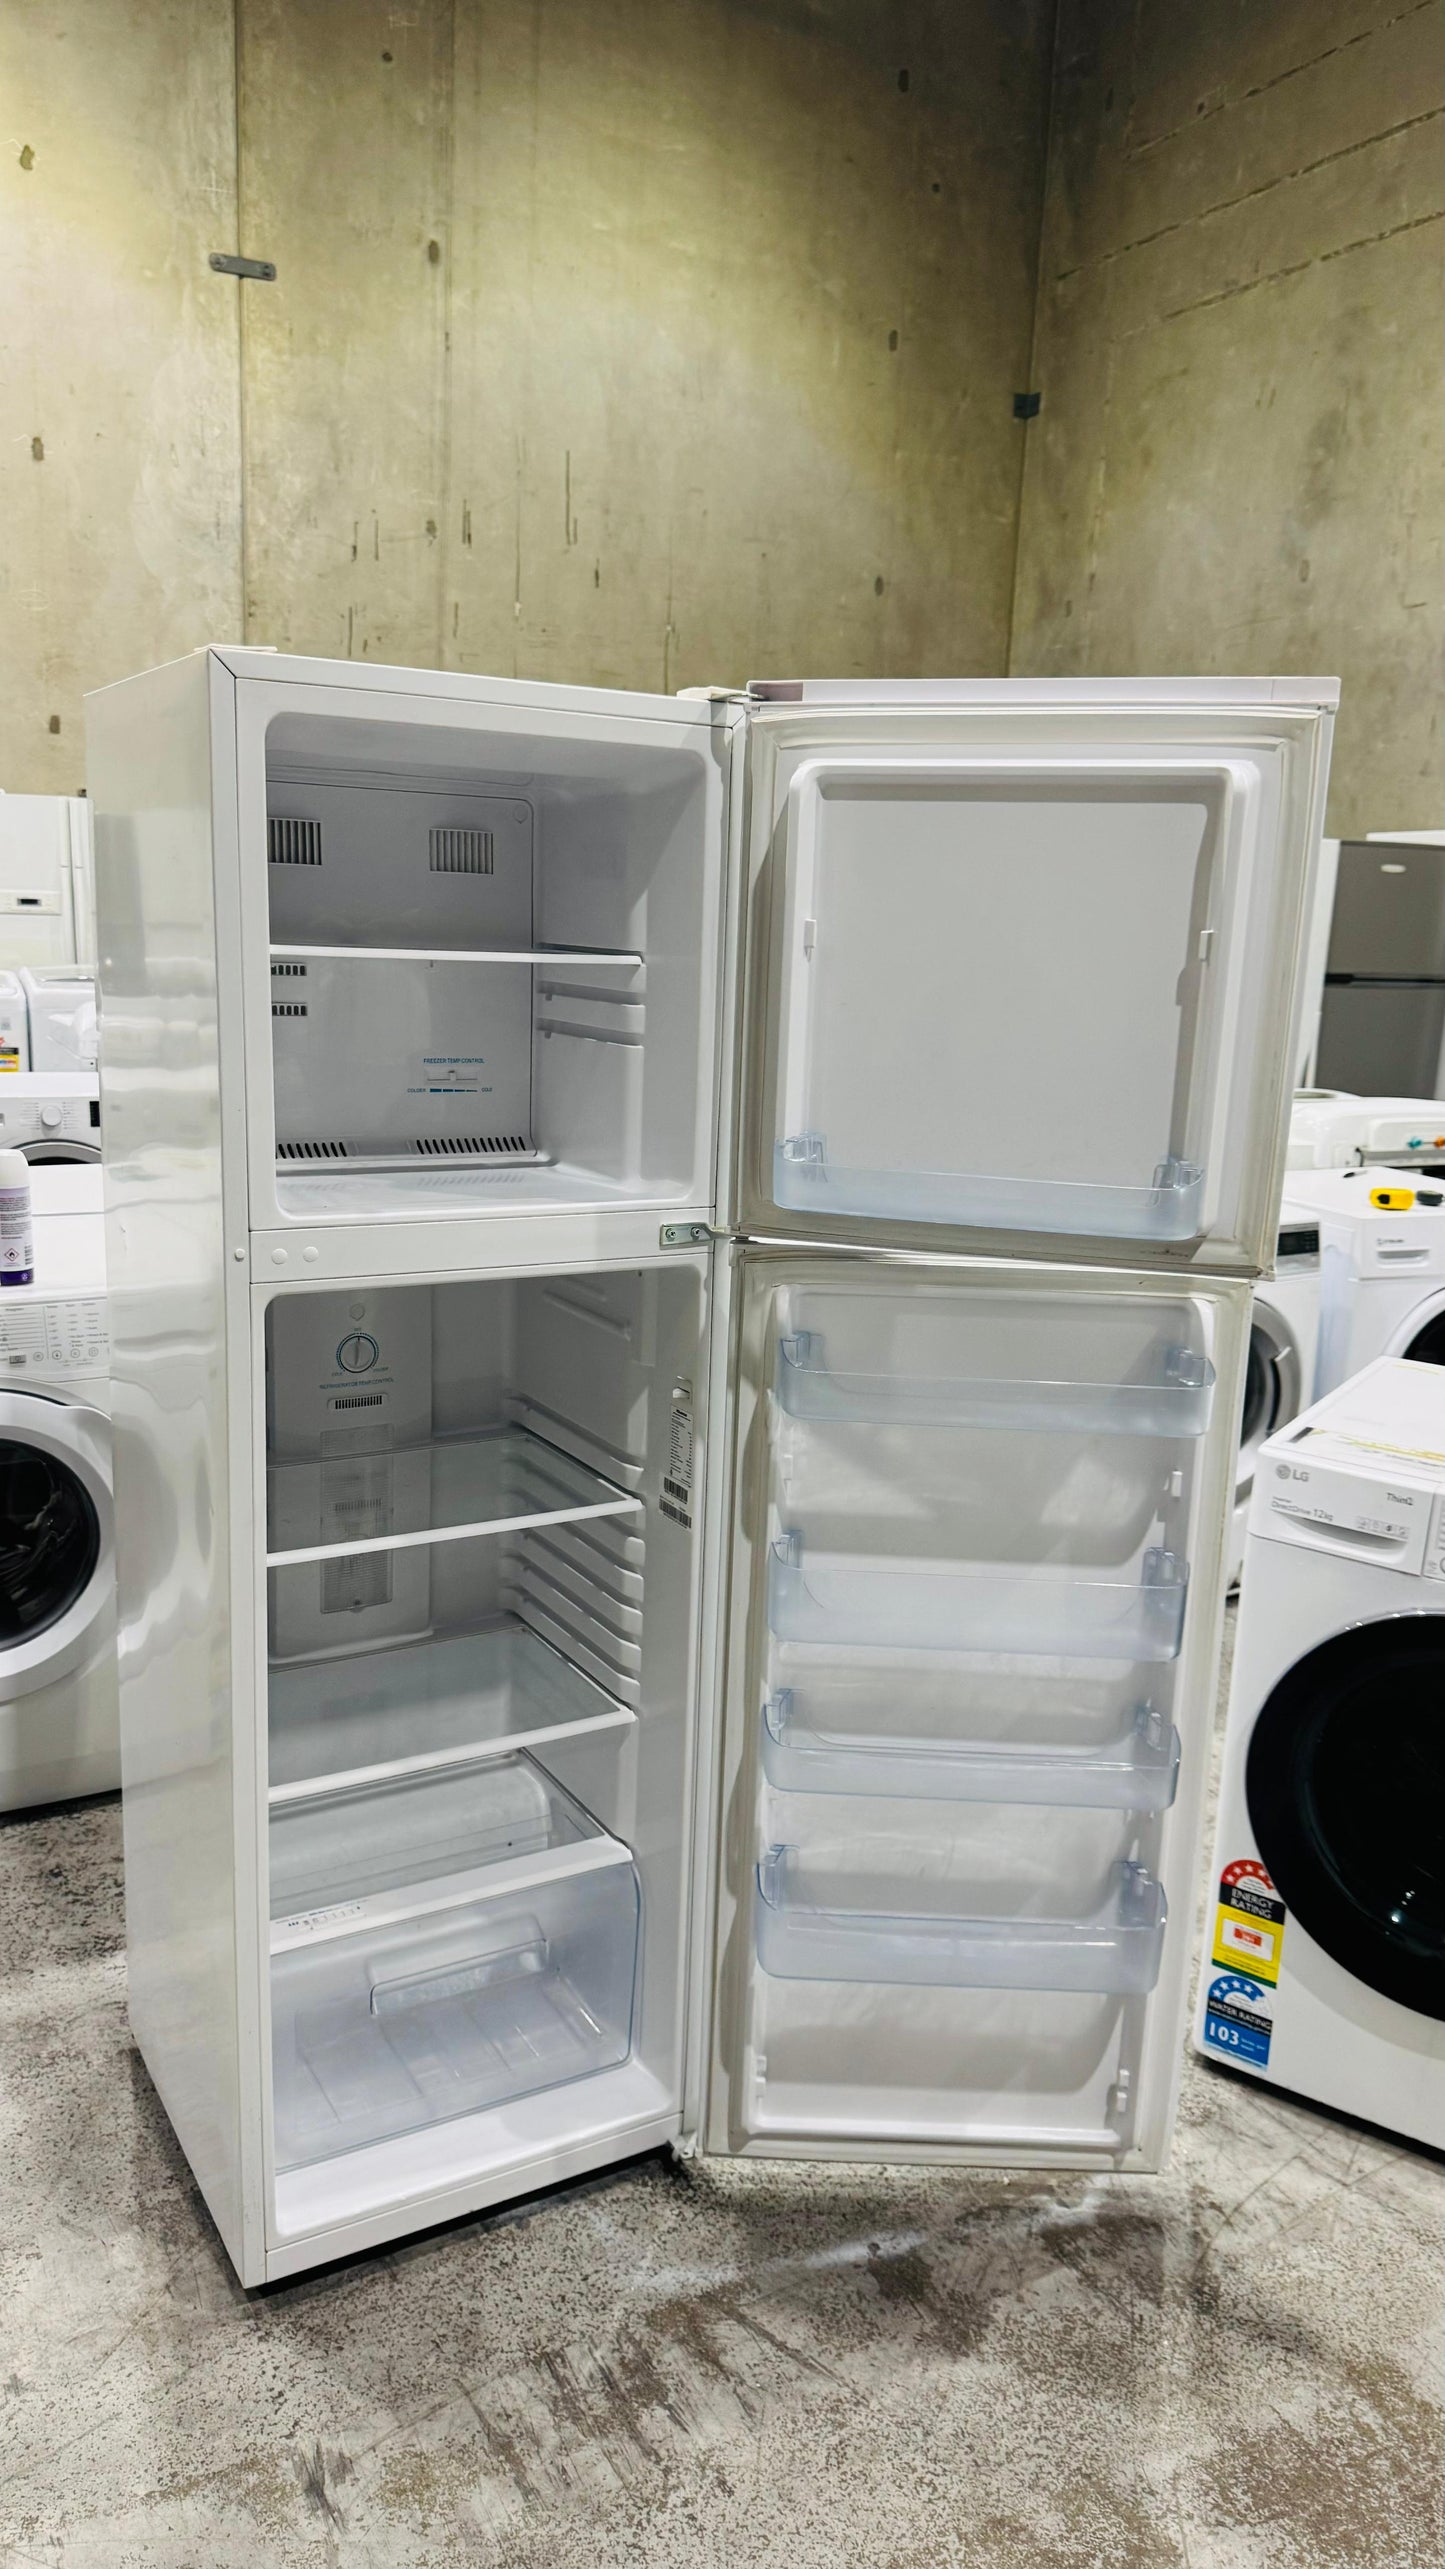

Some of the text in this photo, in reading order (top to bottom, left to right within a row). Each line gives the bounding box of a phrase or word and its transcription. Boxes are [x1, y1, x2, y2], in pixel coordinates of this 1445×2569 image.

[1292, 1469, 1310, 1482] LG
[1230, 1897, 1273, 1920] RATING
[1231, 1887, 1274, 1909] ENERGY
[1209, 2021, 1240, 2046] 103
